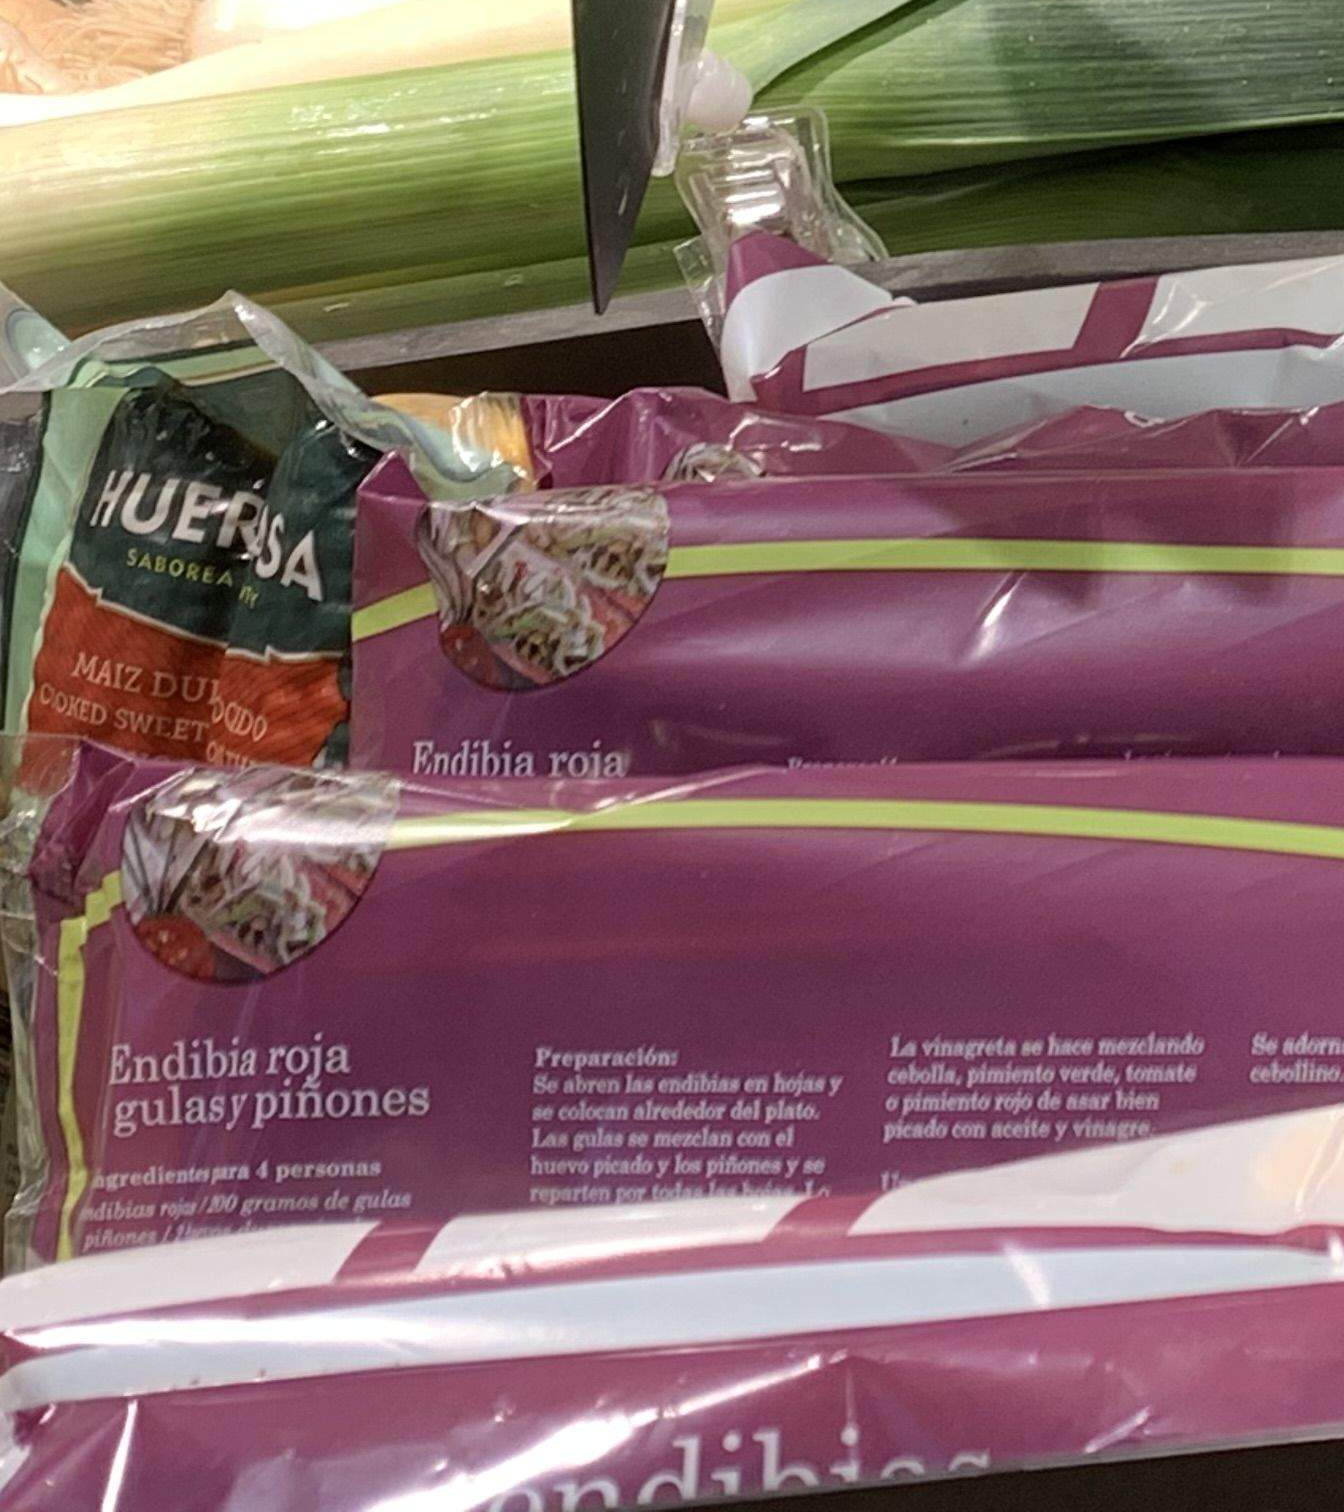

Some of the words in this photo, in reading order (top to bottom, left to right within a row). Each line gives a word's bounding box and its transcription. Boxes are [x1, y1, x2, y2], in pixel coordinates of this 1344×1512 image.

[125, 547, 233, 587] SABOREA
[69, 651, 144, 694] MAIZ
[113, 708, 211, 744] SWEET
[412, 739, 535, 778] Endibia
[548, 740, 629, 778] roja
[889, 1034, 917, 1058] La
[921, 1034, 1017, 1061] vinagreta
[1020, 1039, 1043, 1057] se
[1047, 1032, 1094, 1057] hace
[1098, 1031, 1205, 1057] mezclando
[1250, 1031, 1279, 1056] Se
[108, 1034, 258, 1085] Endibia
[265, 1031, 351, 1082] roja
[534, 1045, 679, 1071] Preparación:
[532, 1074, 557, 1095] Se
[562, 1073, 621, 1095] abren
[624, 1073, 654, 1094] las
[656, 1071, 741, 1095] endibias
[743, 1078, 769, 1094] en
[772, 1071, 825, 1098] hojas
[827, 1075, 844, 1097] y
[966, 1062, 1056, 1089] pimiento
[1125, 1062, 1198, 1085] tomate
[113, 1085, 226, 1138] gulas
[225, 1093, 248, 1131] y
[250, 1078, 431, 1130] piñones
[531, 1105, 555, 1122] se
[557, 1099, 629, 1122] colocan
[633, 1098, 726, 1122] alrededor
[730, 1098, 761, 1121] del
[884, 1093, 899, 1111] o
[902, 1090, 992, 1117] pimiento
[994, 1090, 1033, 1116] rojo
[1036, 1089, 1063, 1111] de
[1065, 1093, 1110, 1111] asar
[1114, 1087, 1160, 1111] bien
[531, 1126, 569, 1149] Las
[572, 1126, 624, 1152] gulas
[627, 1132, 649, 1148] se
[652, 1125, 733, 1149] mezclan
[736, 1131, 772, 1149] con
[775, 1125, 795, 1149] el
[883, 1115, 949, 1144] picado
[951, 1121, 987, 1140] con
[990, 1117, 1050, 1140] aceite
[1054, 1120, 1068, 1143] y
[255, 1160, 268, 1179] 4
[276, 1159, 383, 1183] personas
[530, 1155, 587, 1176] huevo
[592, 1154, 654, 1179] picado
[655, 1159, 670, 1178] y
[674, 1153, 702, 1175] los
[705, 1154, 782, 1179] piñones
[784, 1159, 799, 1178] y
[803, 1157, 826, 1175] se
[239, 1198, 318, 1218] gramos
[323, 1190, 349, 1211] de
[353, 1190, 413, 1216] gulas
